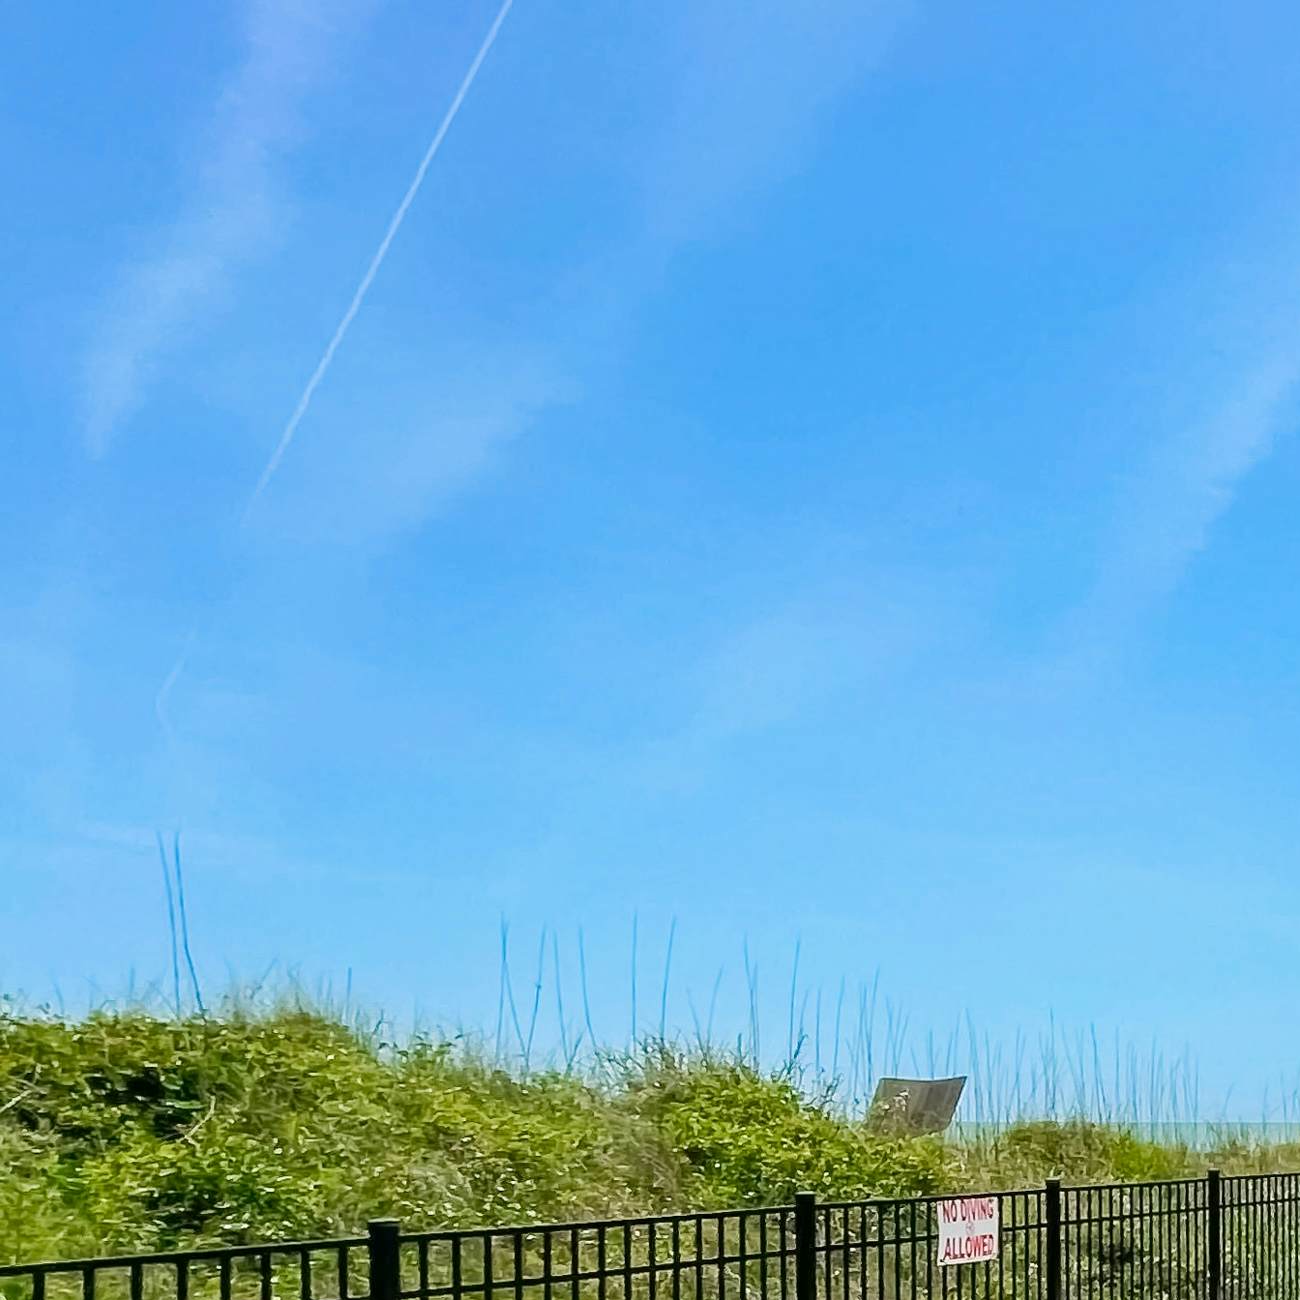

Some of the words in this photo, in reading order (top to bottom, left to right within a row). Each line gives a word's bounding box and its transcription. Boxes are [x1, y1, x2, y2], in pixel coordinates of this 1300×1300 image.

[943, 1200, 958, 1223] NO
[960, 1198, 994, 1222] DIVING
[944, 1234, 994, 1260] ALLOWED
